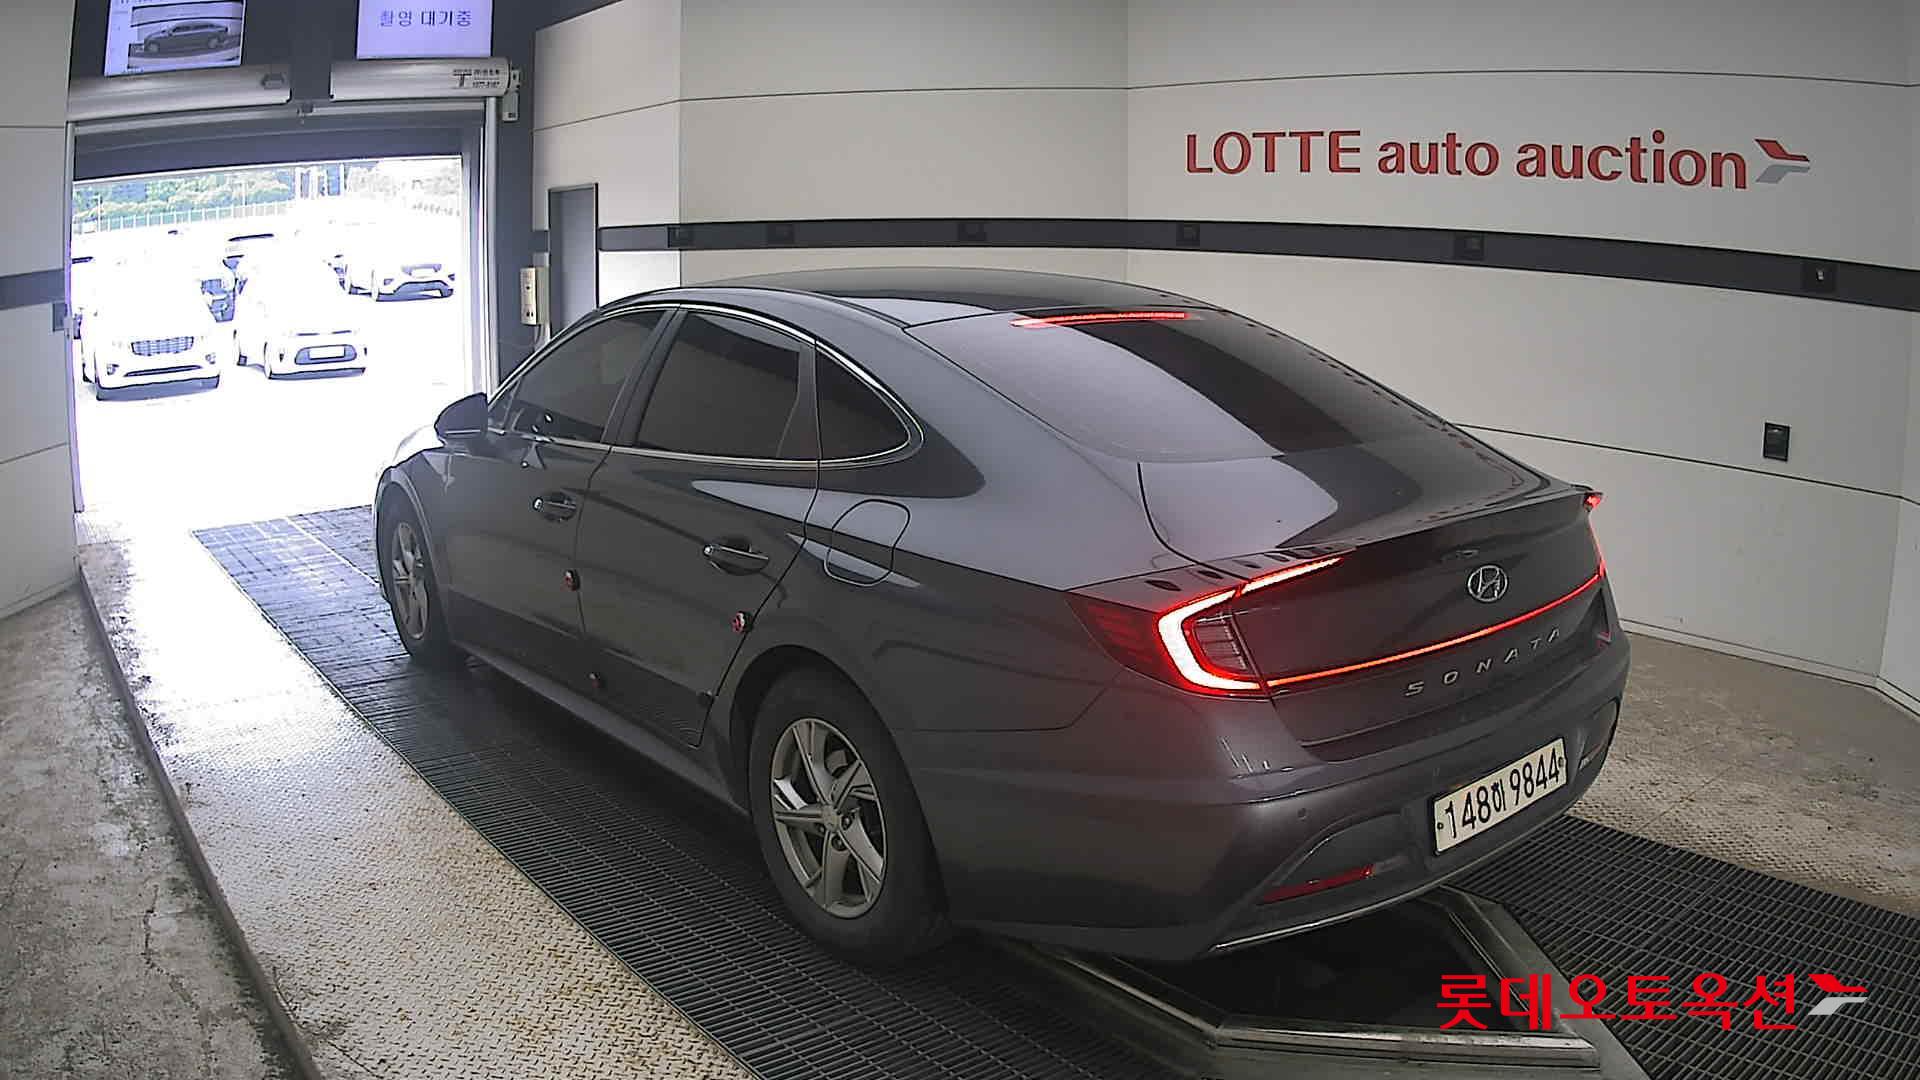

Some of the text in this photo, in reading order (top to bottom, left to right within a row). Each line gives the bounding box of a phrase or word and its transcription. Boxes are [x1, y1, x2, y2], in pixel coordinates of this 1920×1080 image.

[421, 10, 472, 27] 대기중
[1187, 130, 1747, 190] LOTTE auto auction
[1404, 628, 1560, 697] SONATA
[1509, 747, 1560, 806] 9844
